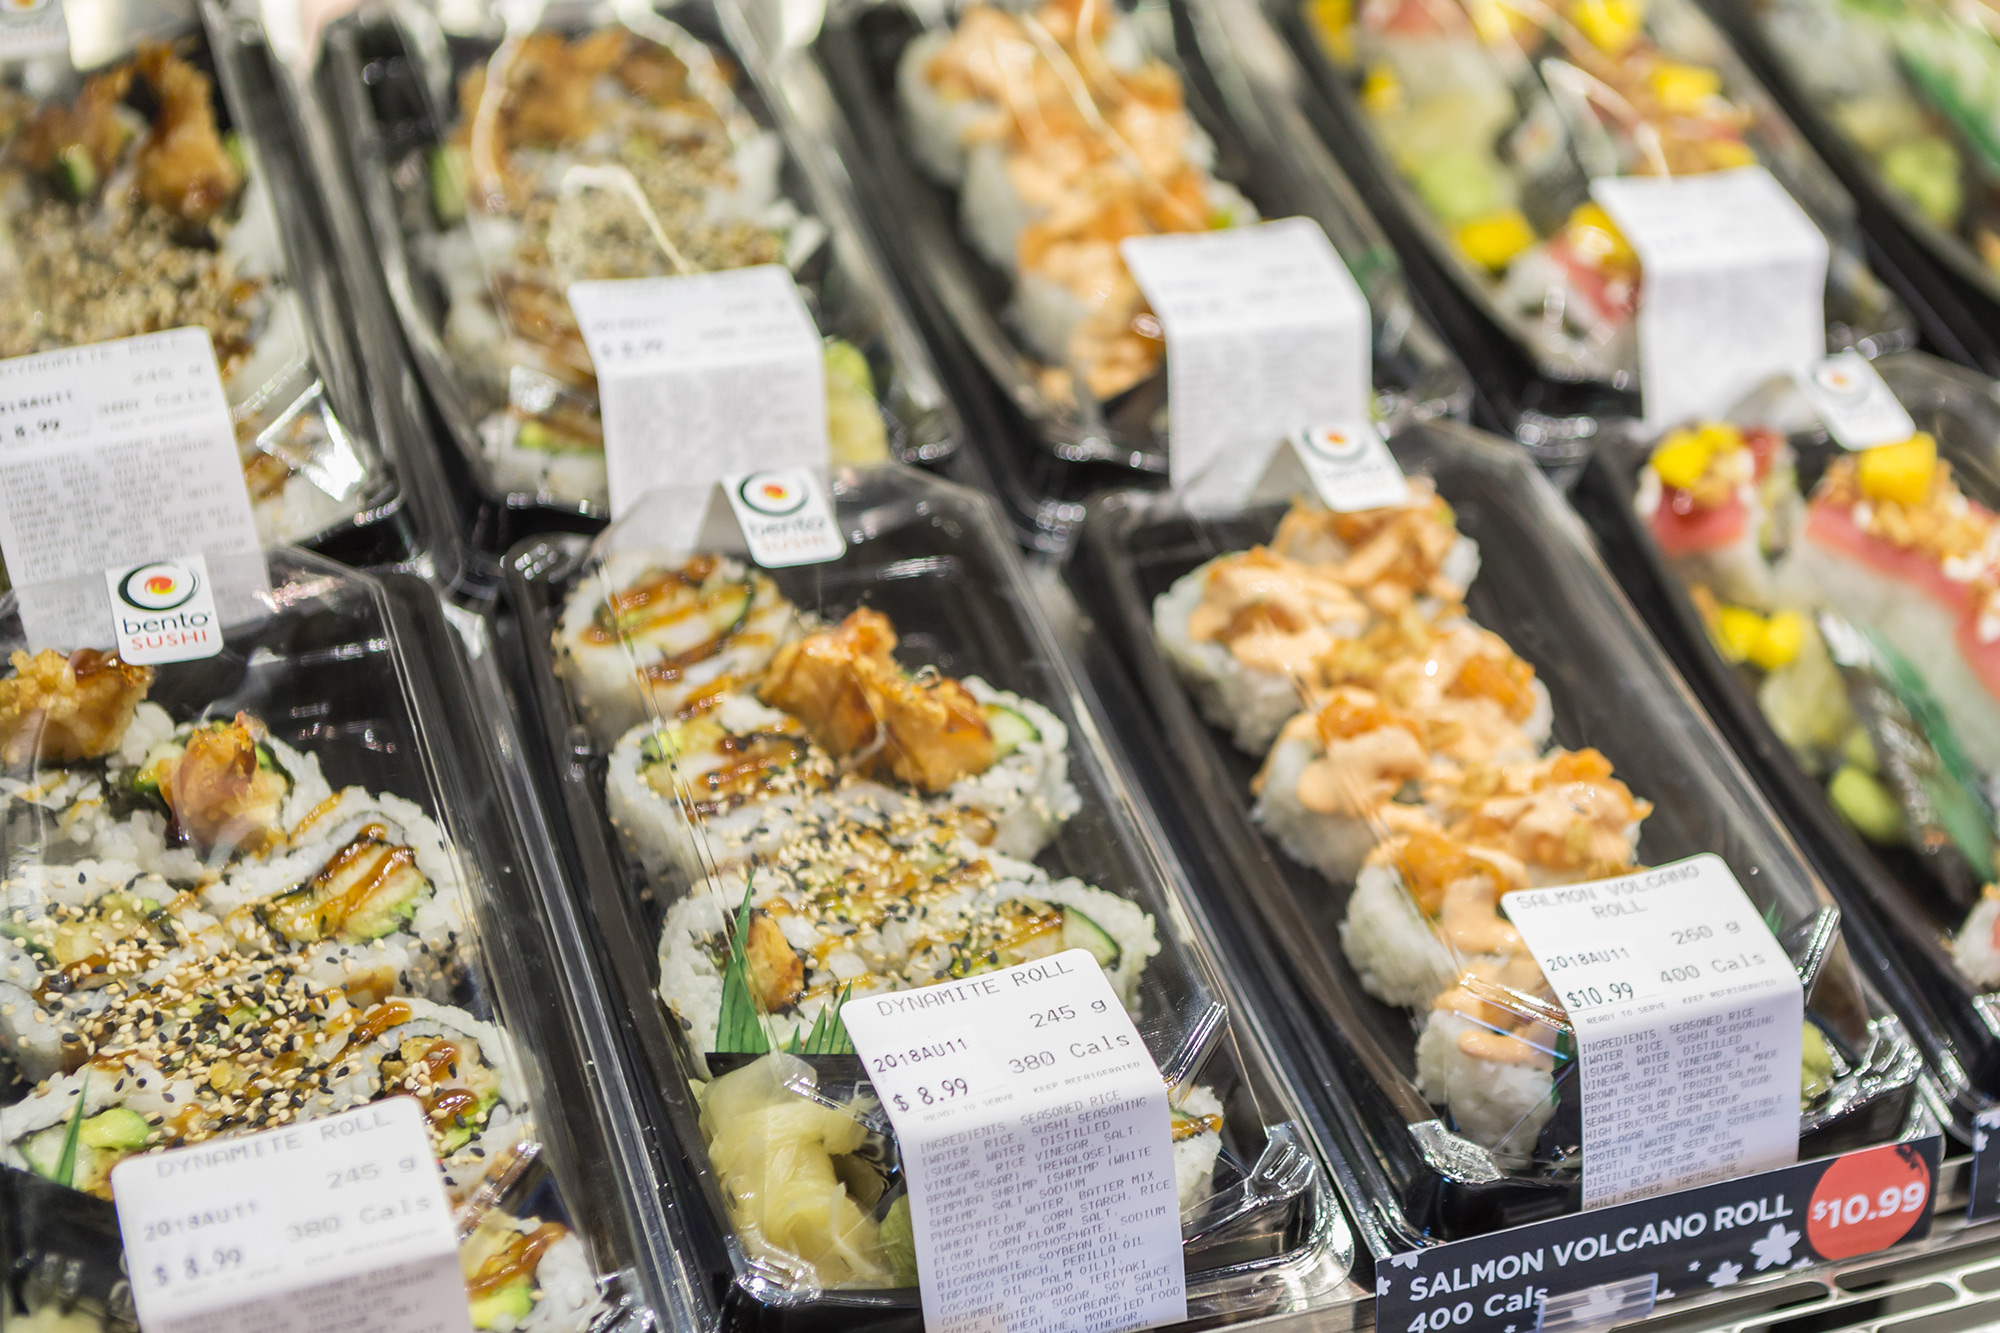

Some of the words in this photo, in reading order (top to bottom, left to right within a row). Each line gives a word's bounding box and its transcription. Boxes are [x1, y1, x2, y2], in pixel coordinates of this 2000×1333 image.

[124, 612, 208, 635] bento
[131, 630, 206, 650] SUSHI
[1516, 889, 1598, 909] SALMON
[1606, 864, 1699, 898] VOLCANO
[1591, 900, 1647, 920] ROLL
[1671, 925, 1713, 945] 260
[1726, 921, 1741, 934] g
[1546, 947, 1631, 972] 2018AU11
[1660, 964, 1700, 985] 400
[1711, 953, 1765, 974] Cals
[876, 979, 1000, 1017] DYNAMITE
[1011, 961, 1073, 987] ROLL
[1567, 981, 1633, 1009] $10.99
[1029, 1005, 1076, 1028] 245
[1091, 1000, 1107, 1013] g
[1729, 1008, 1754, 1021] RICE
[1677, 1030, 1708, 1045] SUSHI
[1683, 1035, 1742, 1056] DISTILLED
[873, 1038, 967, 1073] 2018AU11
[1009, 1051, 1055, 1074] 380
[1070, 1034, 1130, 1059] Cals
[1644, 1063, 1670, 1077] RICE
[1033, 1082, 1058, 1094] KEEP
[1064, 1061, 1141, 1085] REFRIGERATED
[893, 1094, 909, 1112] $
[917, 1077, 968, 1105] 8.99
[1020, 1101, 1082, 1126] SEASONED
[1090, 1090, 1121, 1106] RICE
[1584, 1102, 1611, 1116] FROM
[1617, 1092, 1651, 1107] FRESH
[1683, 1075, 1722, 1092] FROZEN
[1584, 1089, 1618, 1104] BROWN
[1032, 1118, 1068, 1136] SUSHI
[1078, 1097, 1147, 1124] SEASONING
[155, 1132, 302, 1178] DYNAMITE
[320, 1113, 390, 1143] ROLL
[1041, 1121, 1110, 1147] DISTILLED
[1585, 1126, 1611, 1140] HIGH
[326, 1164, 379, 1190] 245
[399, 1155, 416, 1173] g
[996, 1157, 1025, 1173] RICE
[926, 1187, 966, 1205] BROWN
[929, 1194, 984, 1217] TEMPURA
[991, 1180, 1037, 1199] SHRIMP
[1109, 1146, 1152, 1166] (WHITE
[1039, 1178, 1085, 1199] SODIUM
[1079, 1179, 1124, 1201] BATTER
[1132, 1171, 1154, 1184] MIX
[286, 1216, 341, 1244] 380
[360, 1196, 430, 1225] Cals
[935, 1234, 979, 1254] (WHEAT
[1042, 1207, 1073, 1224] CORN
[1140, 1180, 1171, 1196] RICE
[1812, 1182, 1926, 1229] $10.99
[935, 1254, 999, 1279] DISODIUM
[1121, 1206, 1166, 1226] SODIUM
[989, 1235, 1020, 1251] CORN
[1039, 1240, 1092, 1262] SOYBEAN
[1409, 1248, 1544, 1301] SALMON
[1554, 1212, 1708, 1267] VOLCANO
[1713, 1193, 1794, 1234] ROLL
[183, 1247, 242, 1280] 8.99
[940, 1281, 993, 1303] TAPIOCA
[1063, 1246, 1116, 1268] PERILLA
[1090, 1260, 1146, 1284] TERIYAKI
[1104, 1278, 1126, 1292] SOY
[1134, 1265, 1171, 1283] SAUCE
[940, 1292, 994, 1315] COCONUT
[1041, 1270, 1072, 1287] PALM
[1085, 1298, 1144, 1323] MODIFIED
[1151, 1286, 1180, 1302] FOOD
[1407, 1302, 1473, 1333] 400
[1484, 1286, 1549, 1317] Cals
